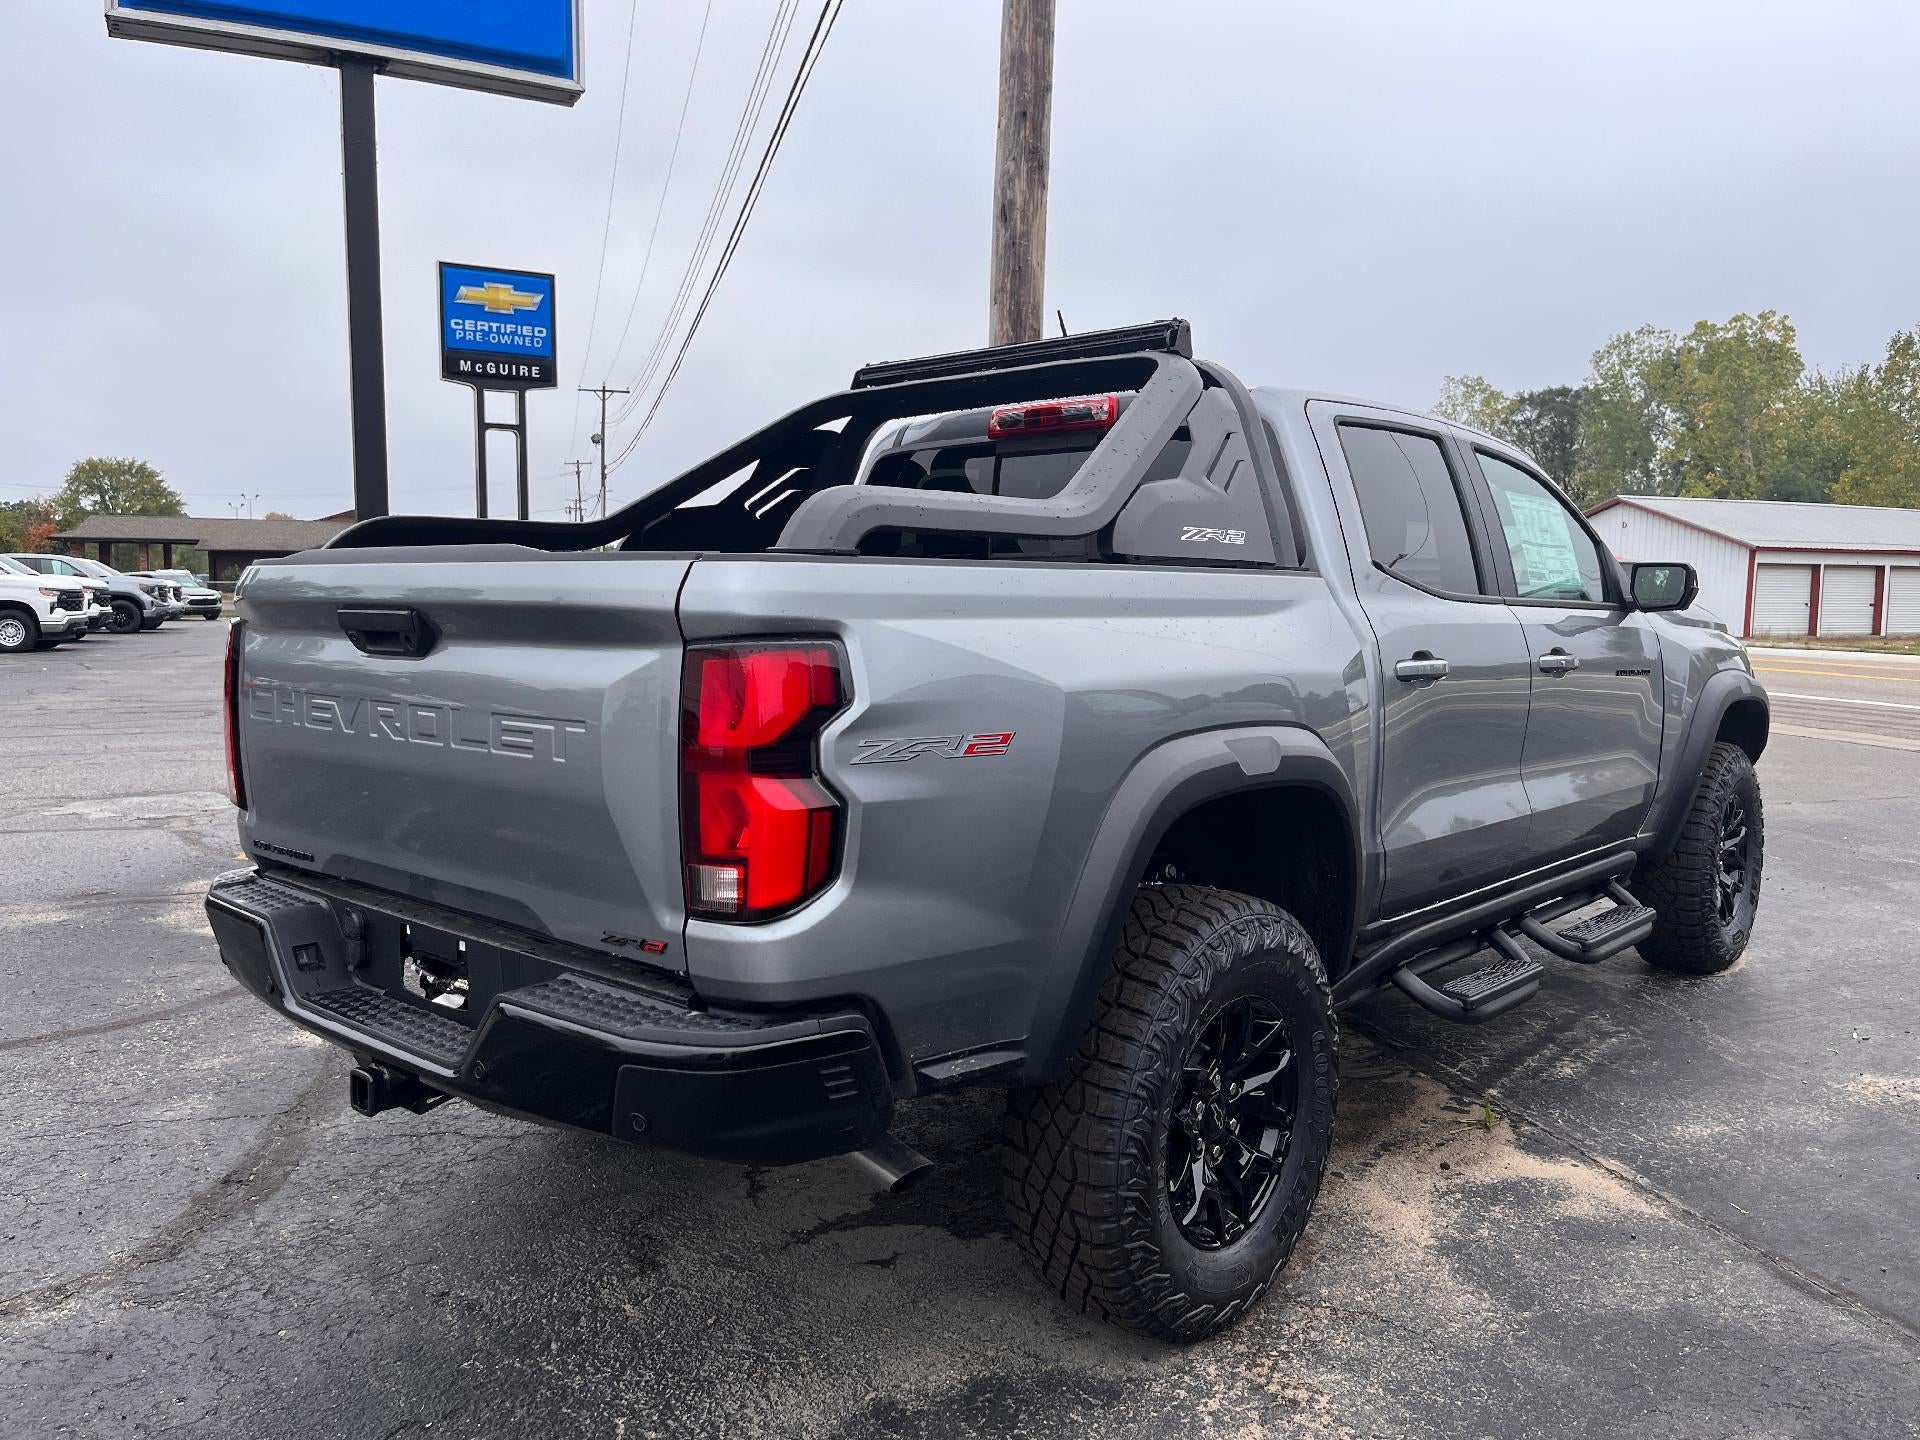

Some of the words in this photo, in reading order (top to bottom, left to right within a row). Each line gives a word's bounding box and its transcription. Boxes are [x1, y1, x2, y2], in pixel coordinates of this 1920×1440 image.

[450, 319, 547, 337] CERTIFIED
[455, 330, 543, 347] PRE-OWNED
[460, 359, 541, 378] McGUIRE
[1180, 526, 1246, 545] ZR2
[249, 686, 587, 763] CHEVROLET
[849, 731, 1017, 766] ZR2
